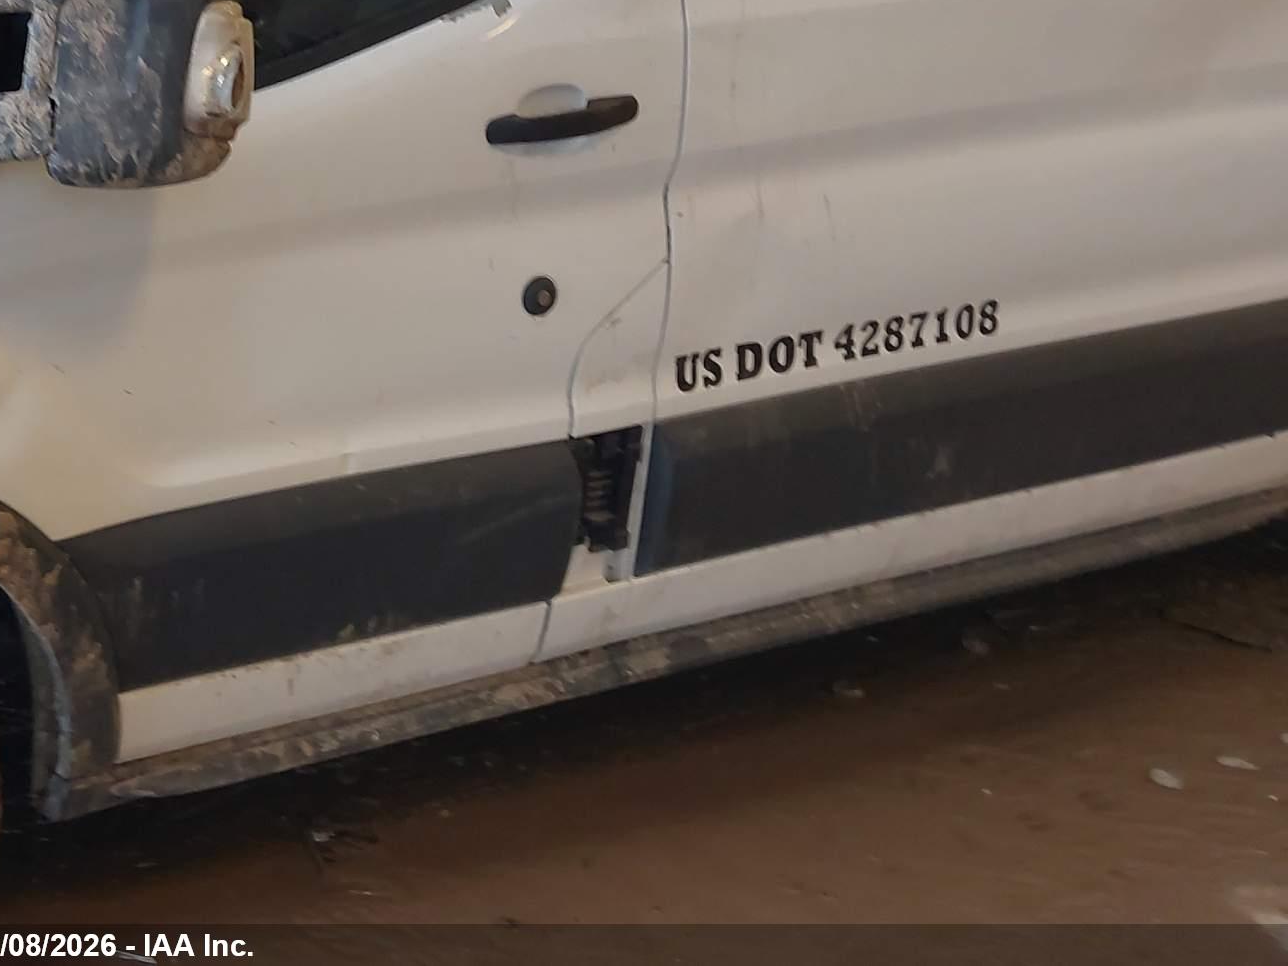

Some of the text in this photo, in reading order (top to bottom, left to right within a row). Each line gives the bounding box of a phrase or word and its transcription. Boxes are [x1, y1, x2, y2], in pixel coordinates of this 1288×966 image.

[674, 299, 1000, 393] US DOT 4287108
